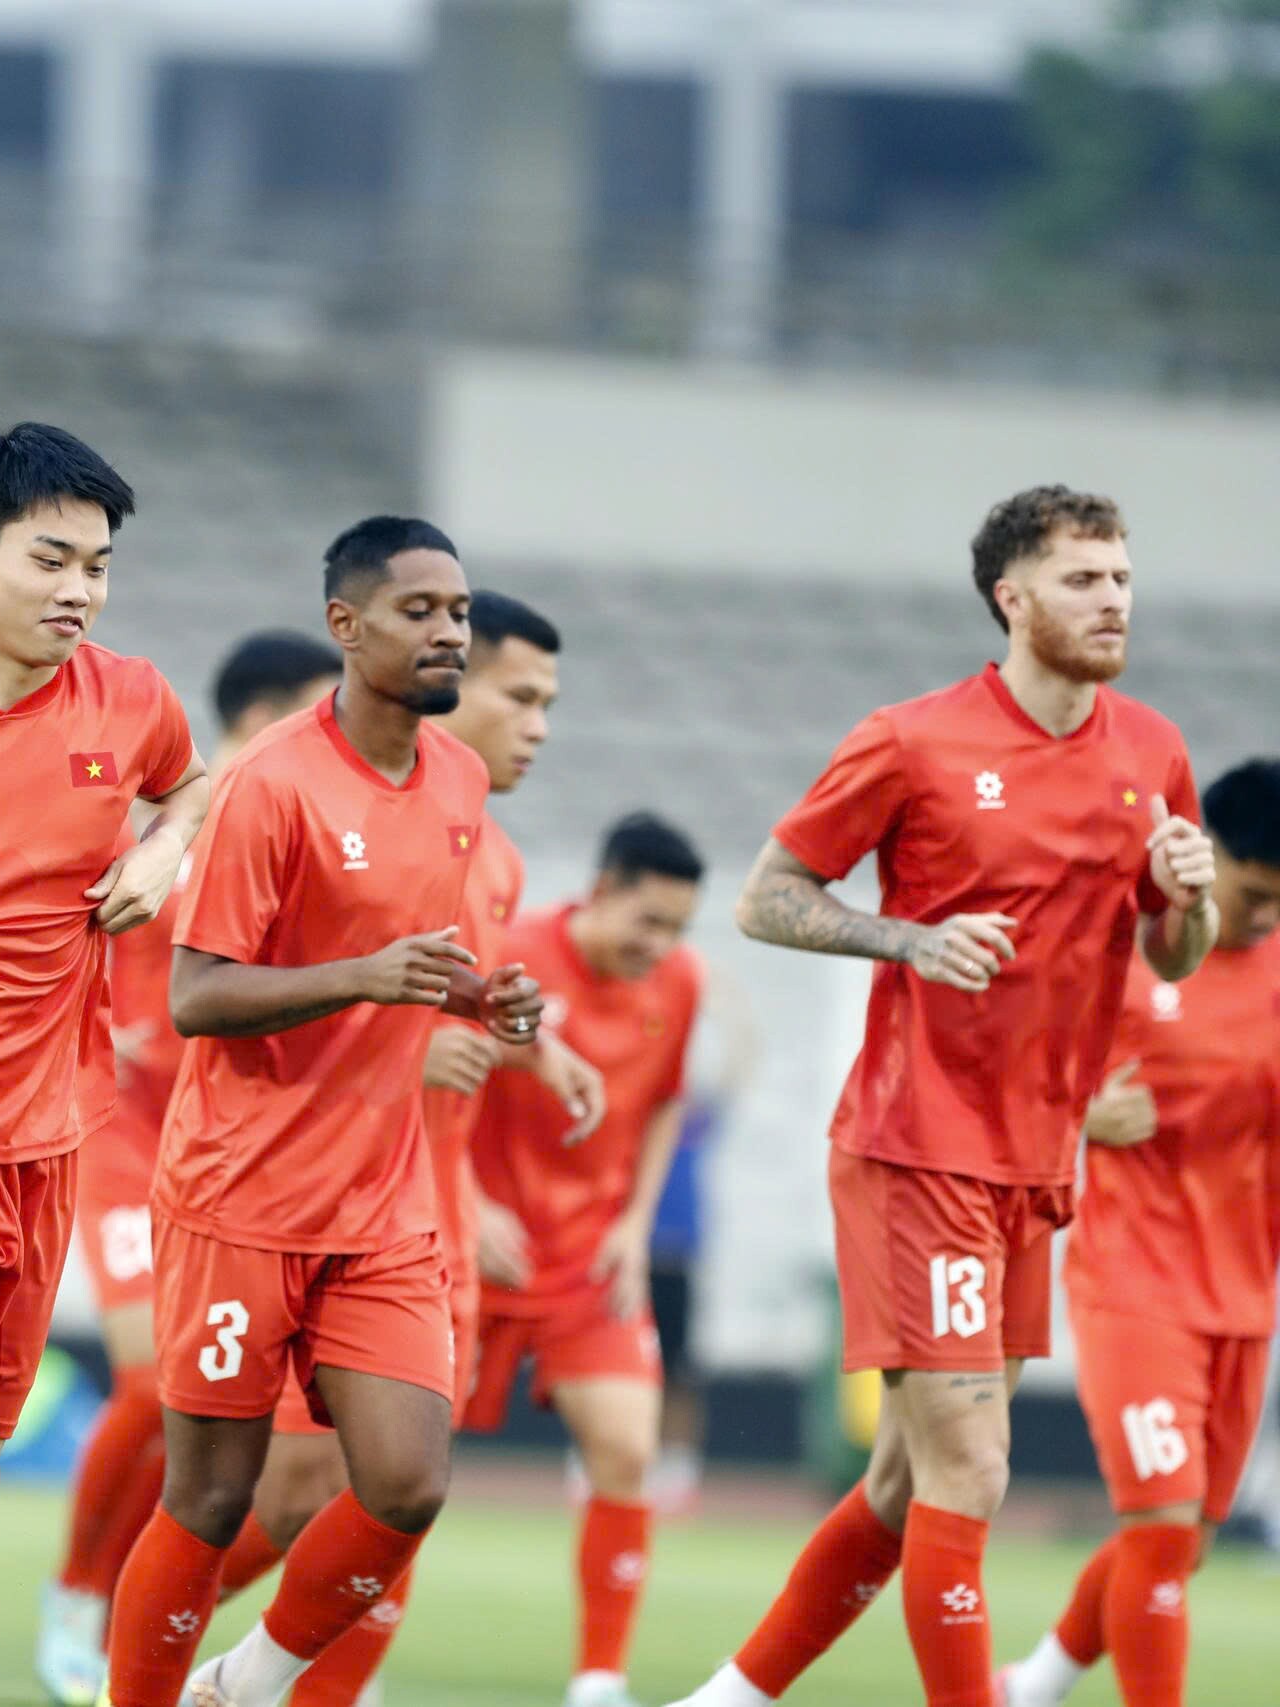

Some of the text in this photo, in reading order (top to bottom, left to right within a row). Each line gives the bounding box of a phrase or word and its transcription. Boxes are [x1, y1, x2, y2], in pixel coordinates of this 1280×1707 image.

[930, 1255, 986, 1339] 13
[197, 1299, 250, 1383] 3
[1121, 1396, 1189, 1481] 16
